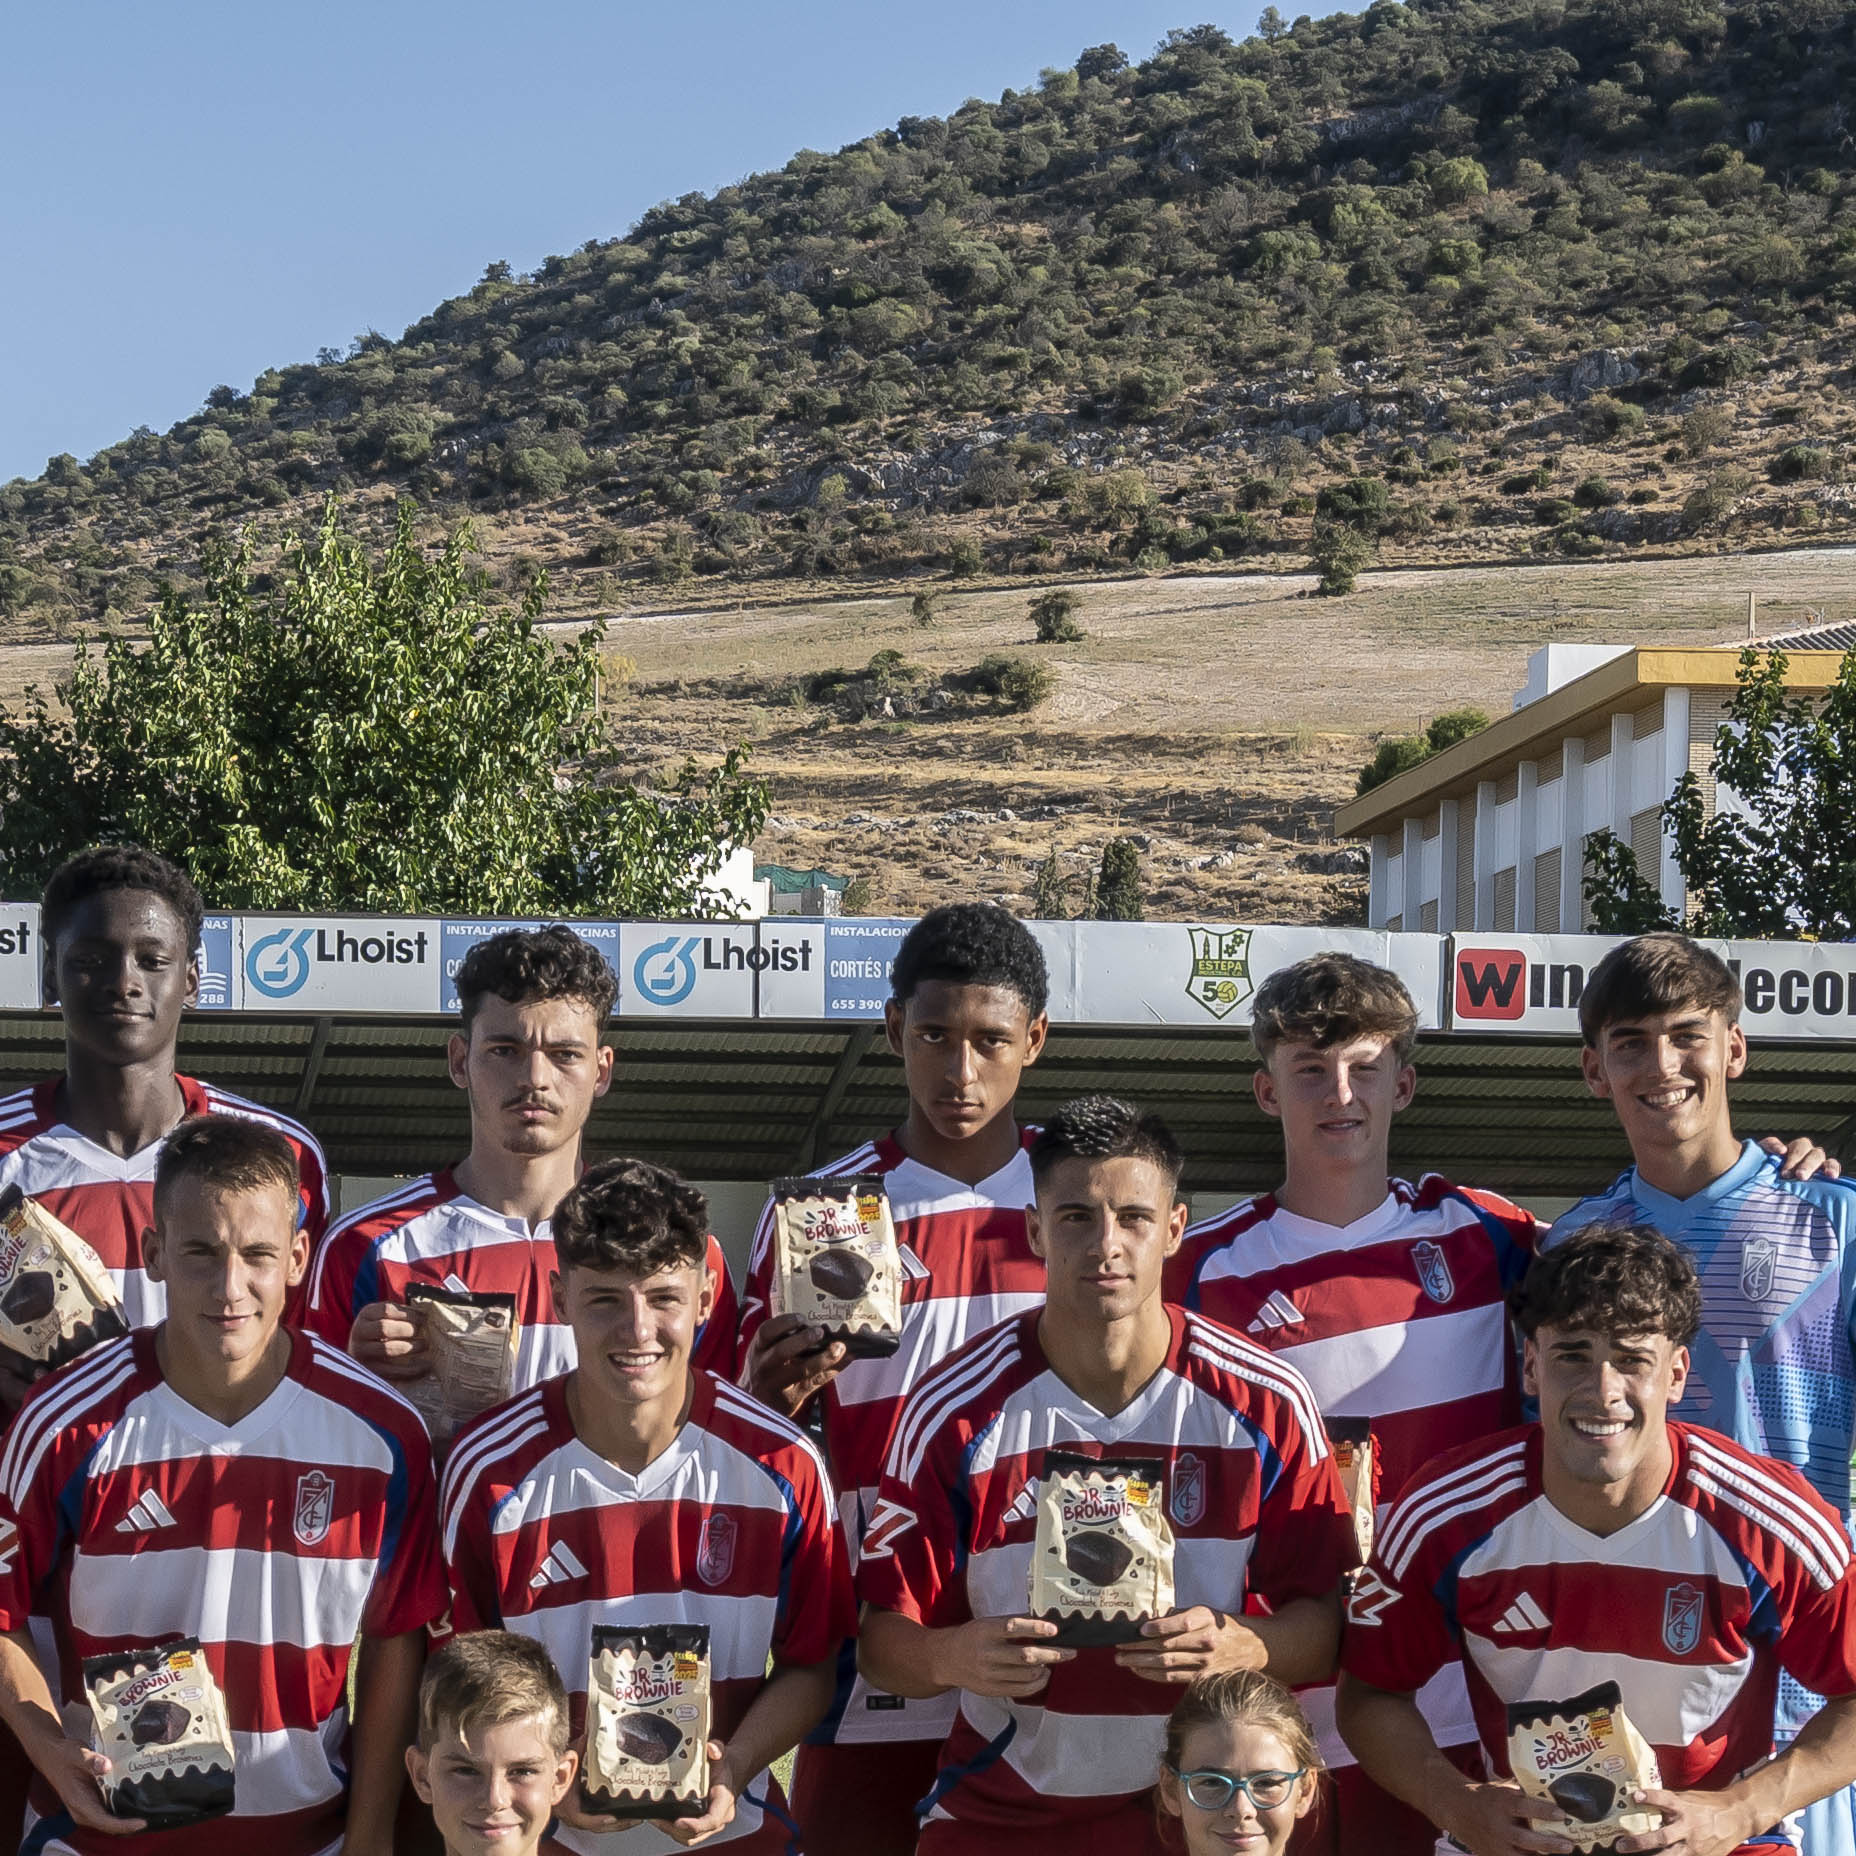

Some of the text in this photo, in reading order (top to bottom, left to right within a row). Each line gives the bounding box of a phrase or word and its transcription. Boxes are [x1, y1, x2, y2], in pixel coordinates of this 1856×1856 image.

[317, 929, 429, 964] Lhoist
[704, 937, 812, 972] Lhoist
[830, 957, 881, 979] CORTÉS
[1198, 961, 1243, 971] ESTEPA
[200, 994, 225, 1005] 288
[831, 1000, 883, 1011] 655 390
[804, 1219, 871, 1242] BROWNIE
[1063, 1498, 1134, 1521] BROWNIE
[615, 1678, 684, 1701] BROWNIE
[1535, 1735, 1608, 1771] BROWNIE
